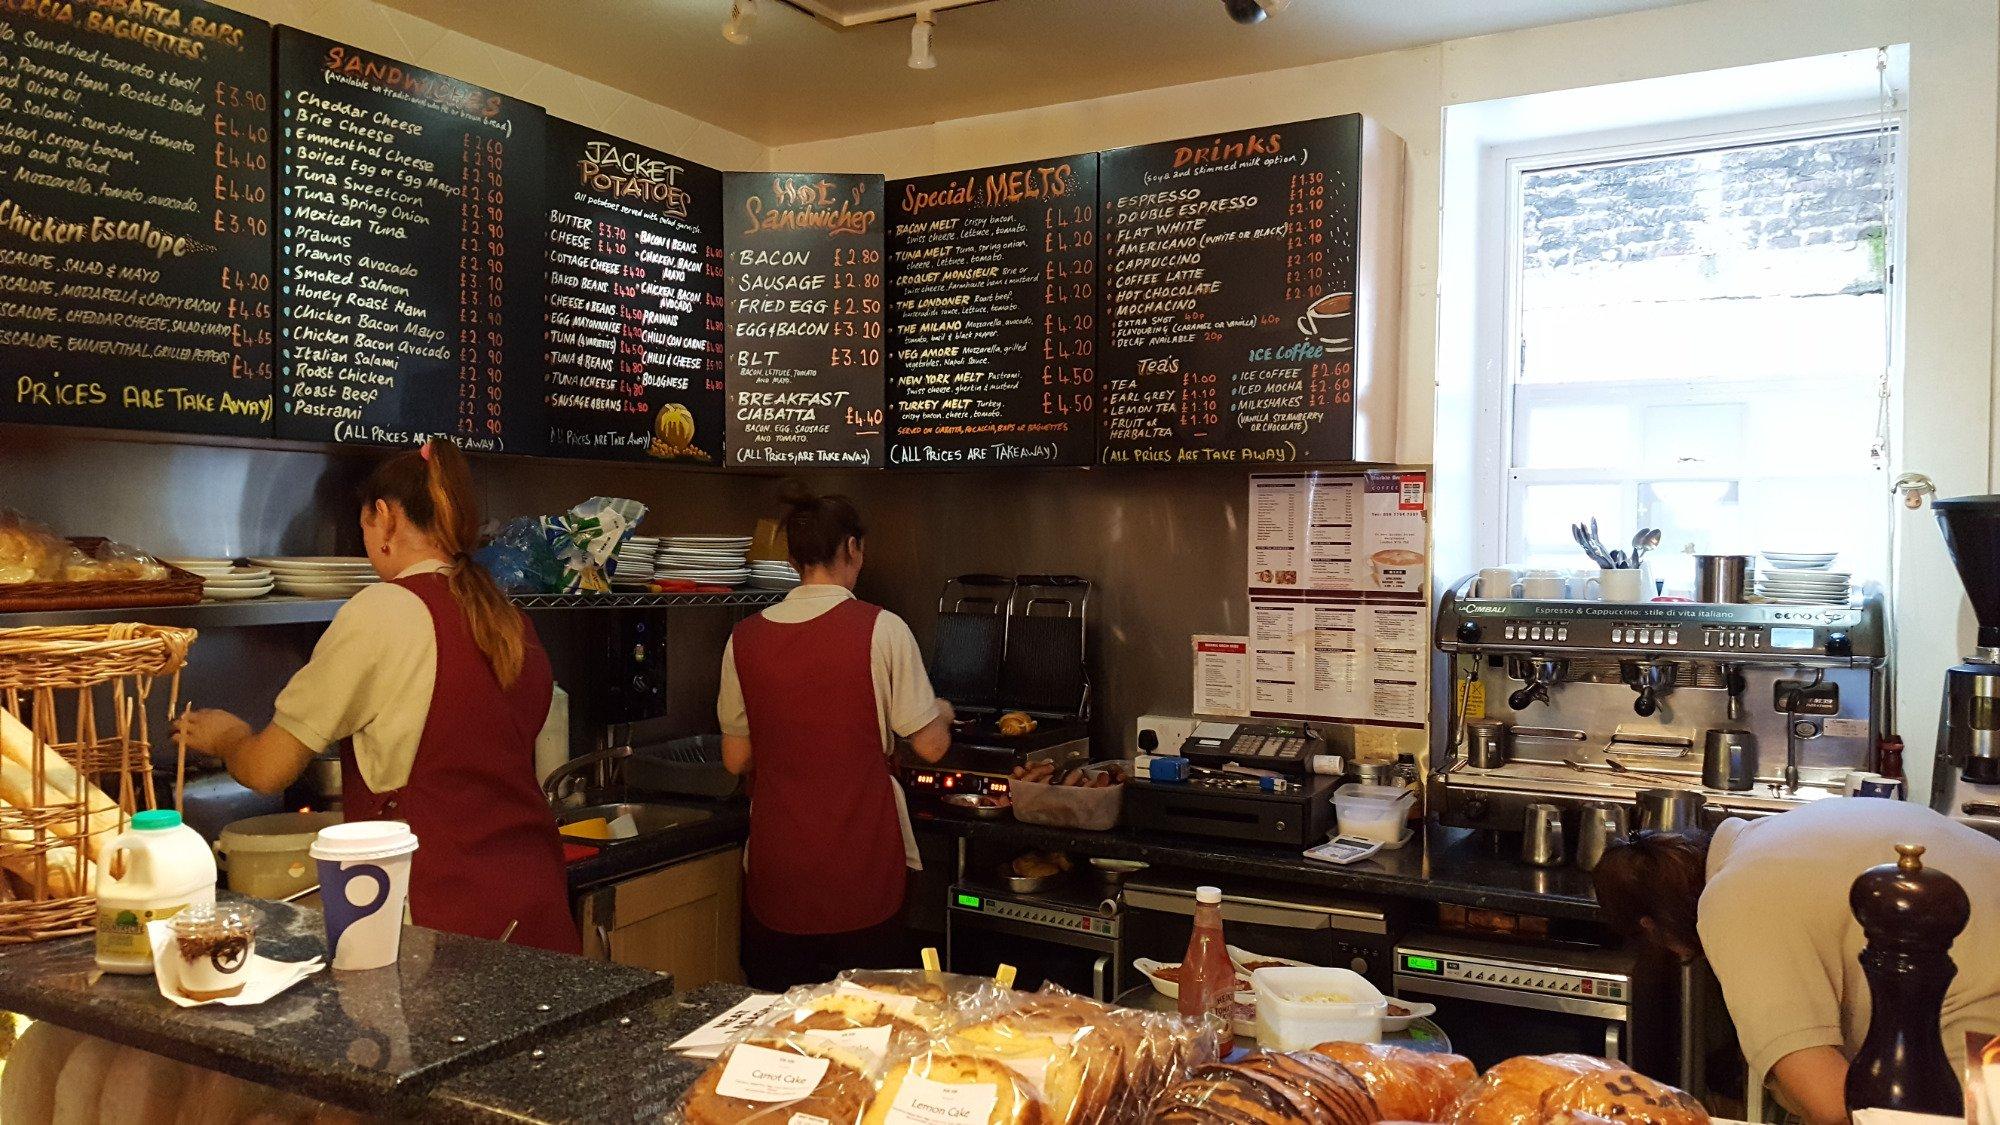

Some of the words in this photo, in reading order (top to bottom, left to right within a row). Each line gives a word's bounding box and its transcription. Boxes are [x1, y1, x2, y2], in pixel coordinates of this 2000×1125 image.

[19, 56, 68, 83] Parma
[297, 91, 368, 119] Cheddar
[373, 111, 423, 136] Cheese
[296, 108, 332, 128] Brie
[340, 119, 394, 144] Cheese
[296, 127, 380, 159] Emmenthal
[386, 149, 434, 173] Cheese
[297, 146, 345, 166] Boiled
[351, 159, 377, 177] Egg
[381, 168, 393, 177] or
[397, 169, 422, 189] Egg
[426, 177, 460, 198] Mayo
[585, 141, 684, 186] JACKET
[296, 165, 337, 186] Tuna
[344, 176, 422, 207] Sweetcorn
[577, 160, 691, 221] POTATOES
[902, 176, 975, 215] Special
[986, 164, 1071, 207] MELTS
[295, 184, 334, 204] Tuna
[392, 206, 430, 225] Onion
[1117, 188, 1201, 209] ESPRESSO
[744, 196, 876, 238] Sandwiches
[1116, 207, 1173, 226] DOUBLE
[1178, 196, 1258, 216] ESPRESSO
[295, 206, 362, 228] Mexican
[369, 220, 408, 239] Tuna
[896, 222, 927, 236] BACON
[930, 218, 959, 231] MELT
[1117, 226, 1154, 242] FLAT
[1156, 218, 1206, 236] WHITE
[91, 216, 186, 258] Escalope
[296, 226, 352, 248] Prawns
[1116, 237, 1196, 256] AMERICANO
[551, 251, 589, 268] COTTAGE
[591, 259, 621, 274] CHEESE
[739, 250, 810, 266] BACON
[895, 249, 921, 261] TUNA
[924, 245, 953, 258] MELT
[1115, 252, 1201, 272] CAPPUCCINO
[63, 258, 103, 275] SALAD
[120, 267, 160, 284] MAYO
[551, 271, 579, 287] BAKED
[896, 272, 941, 287] CROQUET
[943, 266, 999, 282] MONSIEUR
[1116, 273, 1158, 289] COFFEE
[1165, 268, 1205, 284] LATTE
[294, 265, 353, 285] Smoked
[359, 276, 410, 297] Salmon
[738, 274, 825, 292] SAUSAGE
[295, 284, 342, 308] Honey
[347, 293, 388, 310] Roast
[394, 300, 427, 318] Ham
[1116, 290, 1142, 303] HOT
[1145, 280, 1222, 300] CHOCOLATE
[738, 294, 785, 314] FRIED
[790, 299, 828, 314] EGG
[897, 301, 914, 310] THE
[918, 295, 970, 308] LONDONER
[1116, 299, 1196, 316] MOCHACINO
[551, 312, 570, 326] EGG
[898, 325, 918, 335] THE
[920, 321, 962, 334] MILANO
[1204, 331, 1223, 342] 20p
[294, 346, 348, 363] Italian
[355, 352, 399, 370] Salami
[738, 350, 779, 366] BLT
[898, 350, 918, 360] VEG
[921, 346, 959, 358] AMORE
[1249, 347, 1272, 363] ICE
[296, 363, 334, 378] Roast
[339, 369, 394, 388] Chicken
[642, 372, 689, 390] BOLOGNESE
[898, 377, 922, 388] NEW
[925, 374, 950, 384] YORK
[954, 372, 984, 384] MELT
[1240, 371, 1255, 381] ICE
[1259, 368, 1302, 380] COFFEE
[293, 382, 336, 398] Roast
[342, 386, 378, 404] Beef
[1111, 380, 1137, 390] TEA
[1238, 384, 1261, 395] ICED
[1265, 382, 1303, 393] MOCHA
[738, 391, 850, 407] BREAKFAST
[899, 401, 940, 411] TURKEY
[942, 399, 973, 410] MELT
[1111, 392, 1142, 403] EARL
[1144, 391, 1175, 401] GREY
[1238, 396, 1303, 411] MILKSHAKES
[295, 400, 362, 420] Pastrami
[737, 408, 816, 421] CIABATTA
[1111, 405, 1151, 416] LEMON
[1156, 403, 1177, 413] TEA
[967, 448, 987, 461] ARE
[1466, 603, 1507, 614] CIMBALI
[1535, 606, 1574, 615] Espresso
[1645, 608, 1664, 616] stile
[1666, 609, 1676, 617] di
[1698, 609, 1734, 618] italiano
[752, 1070, 781, 1082] Carrot
[783, 1075, 807, 1085] Cake
[911, 1099, 945, 1116] Lemon
[948, 1107, 970, 1118] Cake
